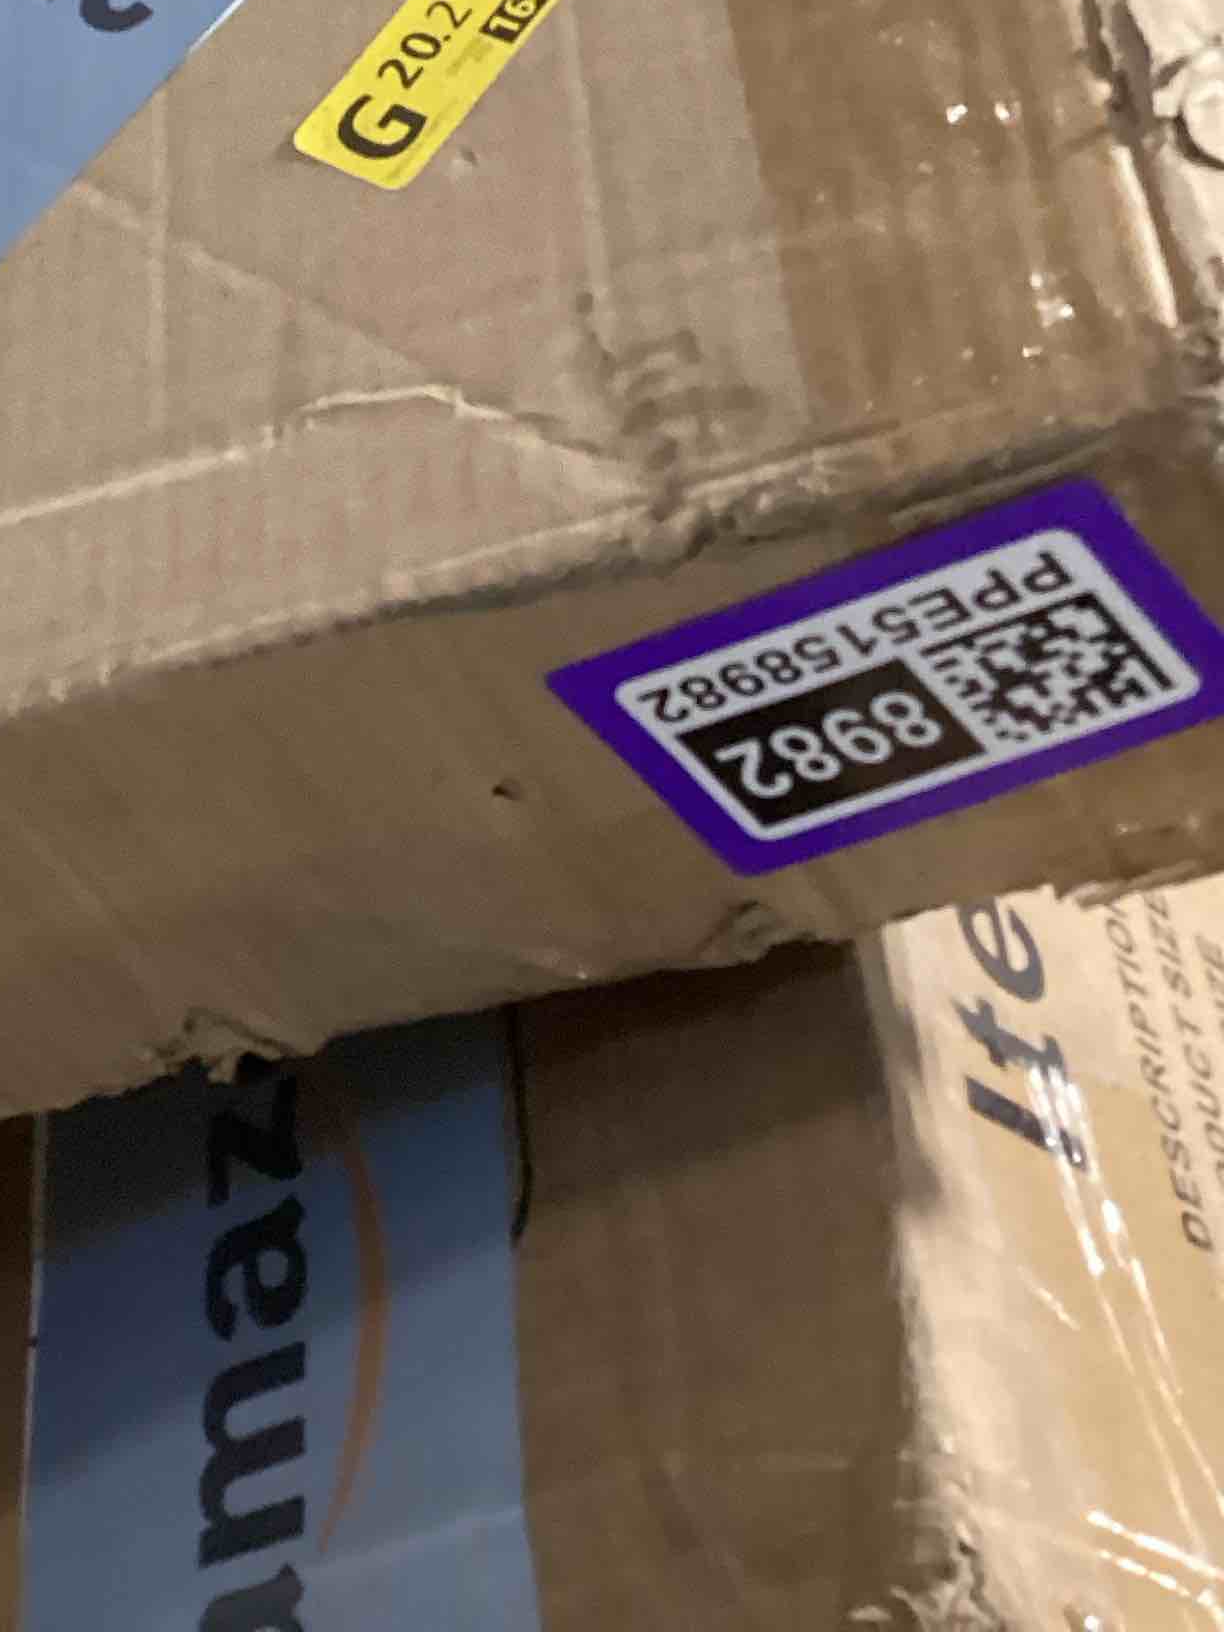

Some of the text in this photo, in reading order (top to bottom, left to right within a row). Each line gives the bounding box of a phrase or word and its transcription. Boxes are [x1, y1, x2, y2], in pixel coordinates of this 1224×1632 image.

[337, 94, 428, 159] G
[635, 549, 1075, 724] PPE5158982
[713, 690, 944, 800] 8982
[950, 896, 1086, 1172] Ite
